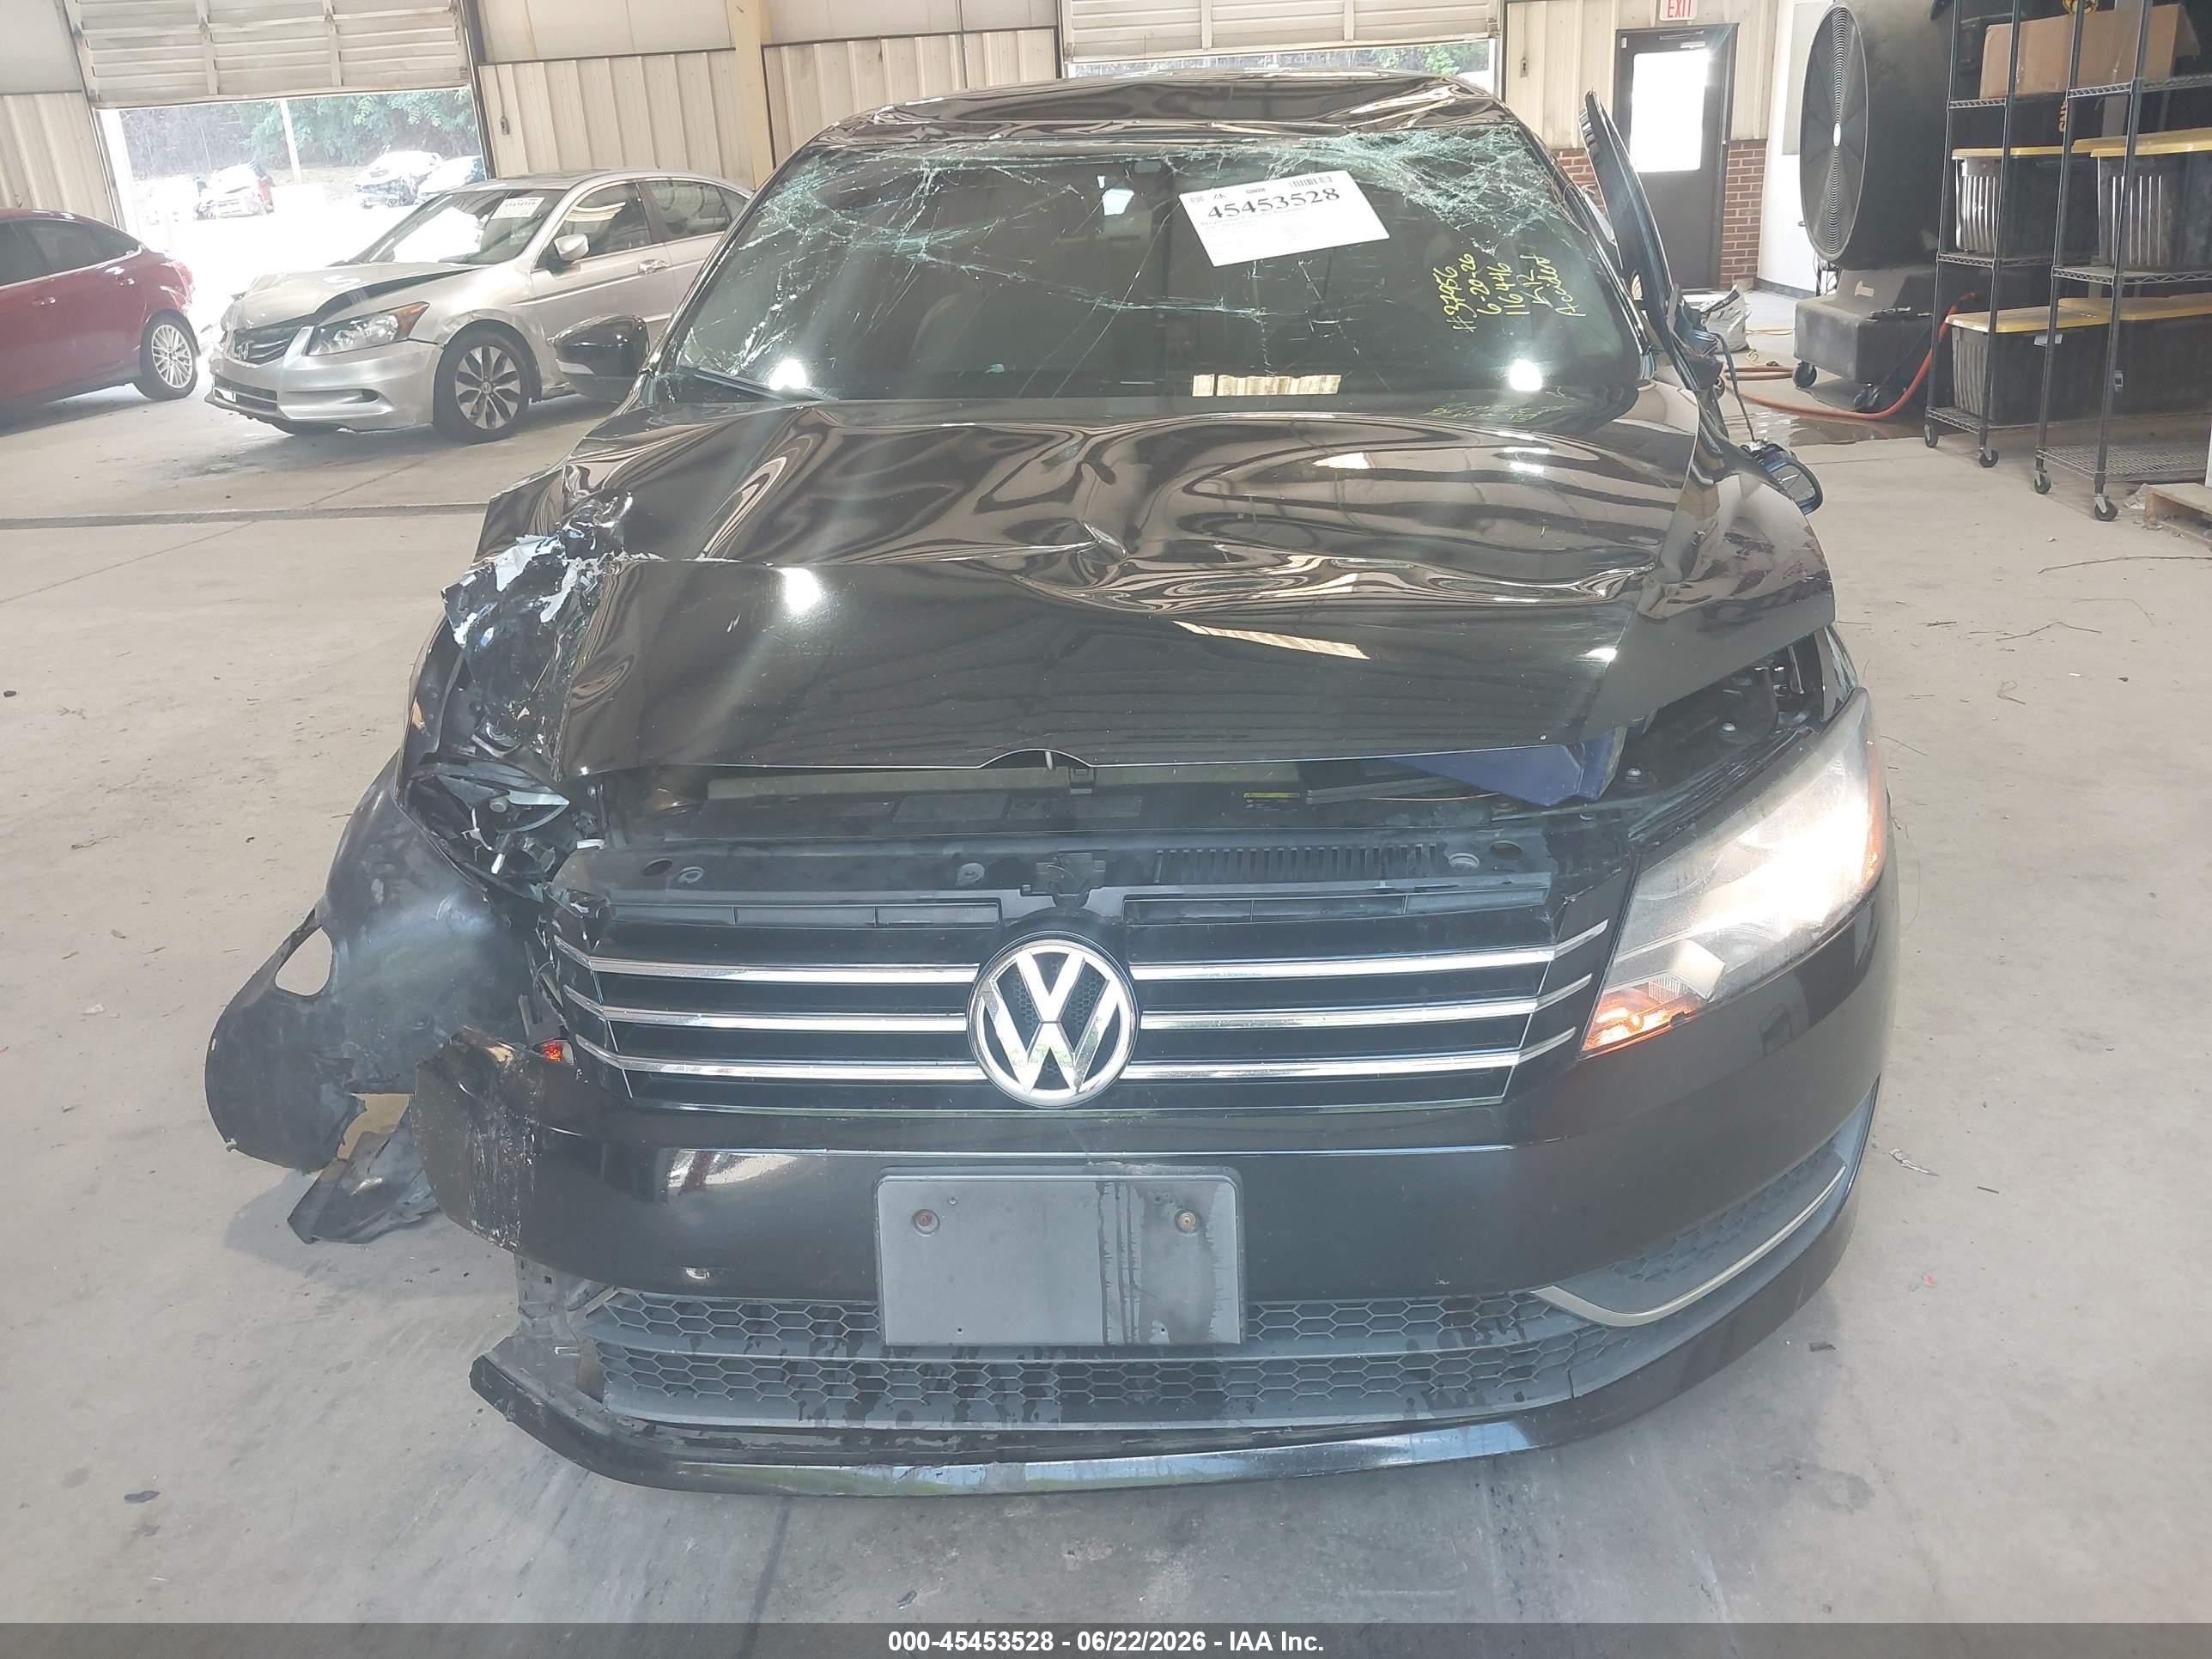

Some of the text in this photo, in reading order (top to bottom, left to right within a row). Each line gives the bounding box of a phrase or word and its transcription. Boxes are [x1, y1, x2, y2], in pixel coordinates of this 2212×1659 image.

[1668, 0, 1692, 18] EXIT
[1207, 187, 1340, 218] 45453528
[1431, 264, 1478, 333] #37956
[1458, 253, 1503, 315] 6-20-26
